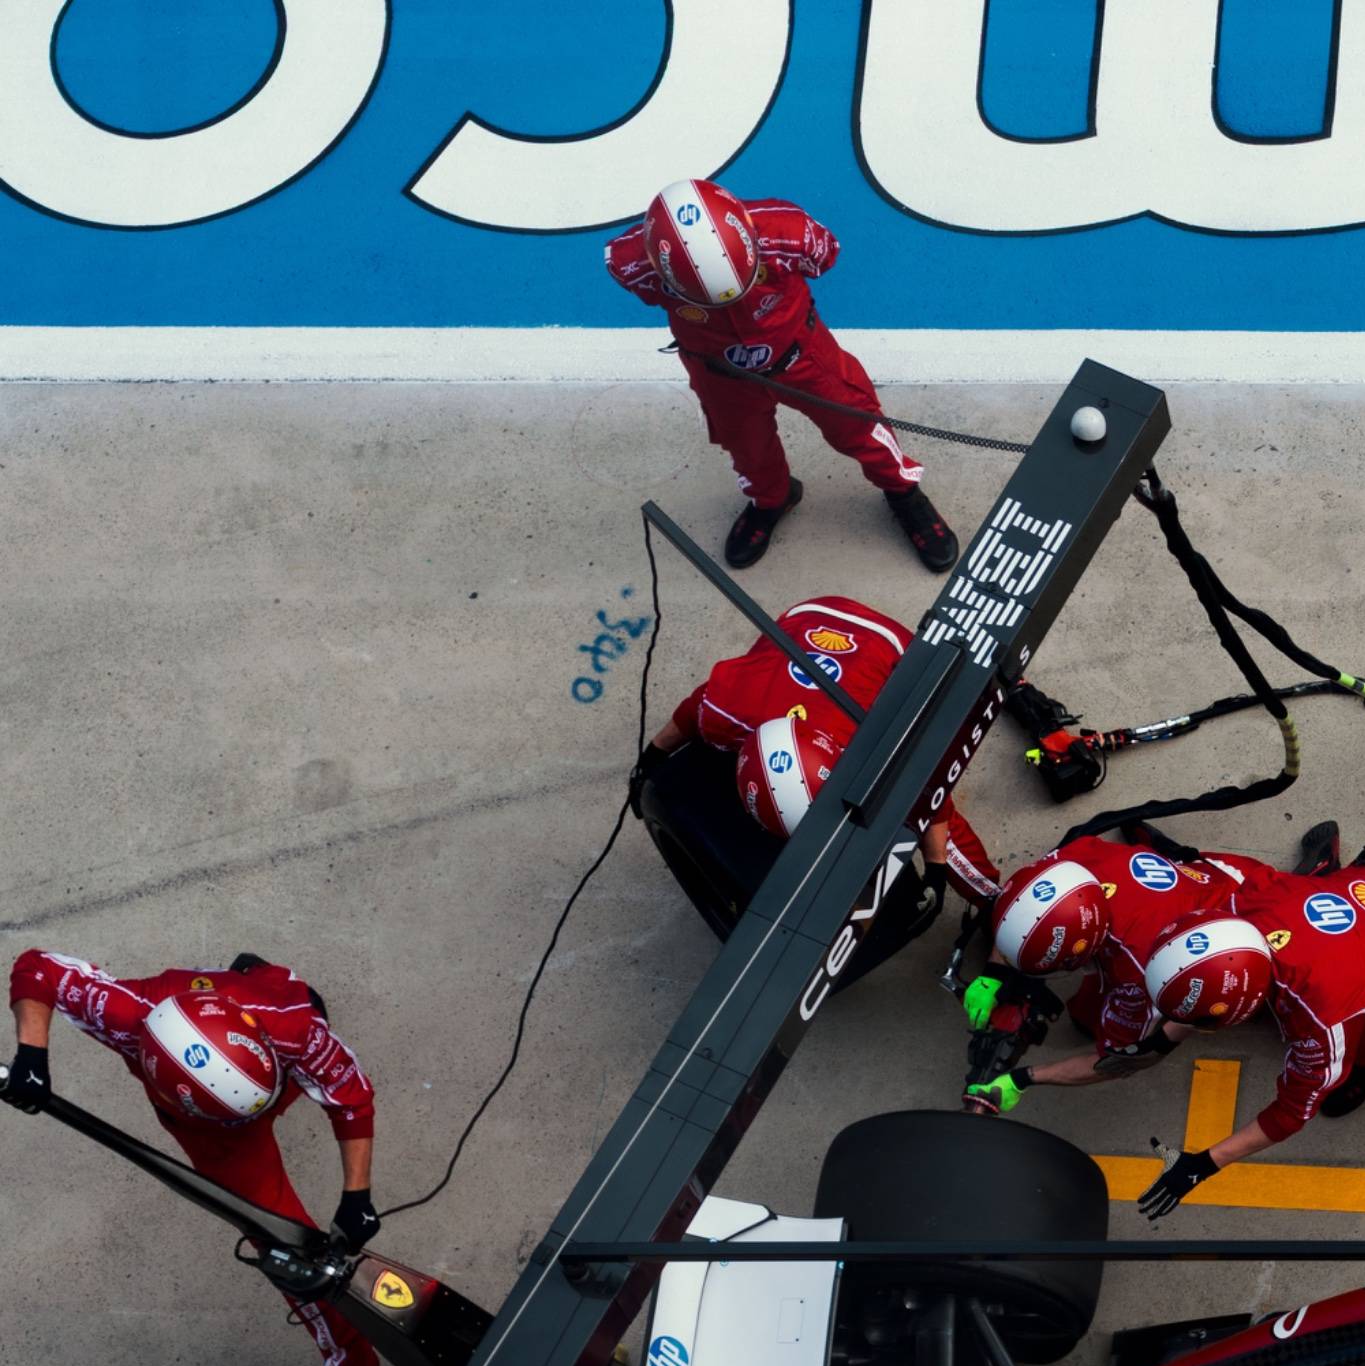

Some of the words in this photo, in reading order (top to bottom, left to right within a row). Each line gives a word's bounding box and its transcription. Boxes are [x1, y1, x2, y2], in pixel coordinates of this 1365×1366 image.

[678, 204, 700, 226] hp
[922, 497, 1072, 668] IBM
[918, 644, 1030, 833] LOGISTIS
[769, 750, 793, 773] hp
[1131, 853, 1177, 891] hp
[1033, 880, 1056, 902] hp
[1305, 893, 1355, 934] hp
[1185, 932, 1210, 955] hp
[184, 1044, 210, 1069] hp
